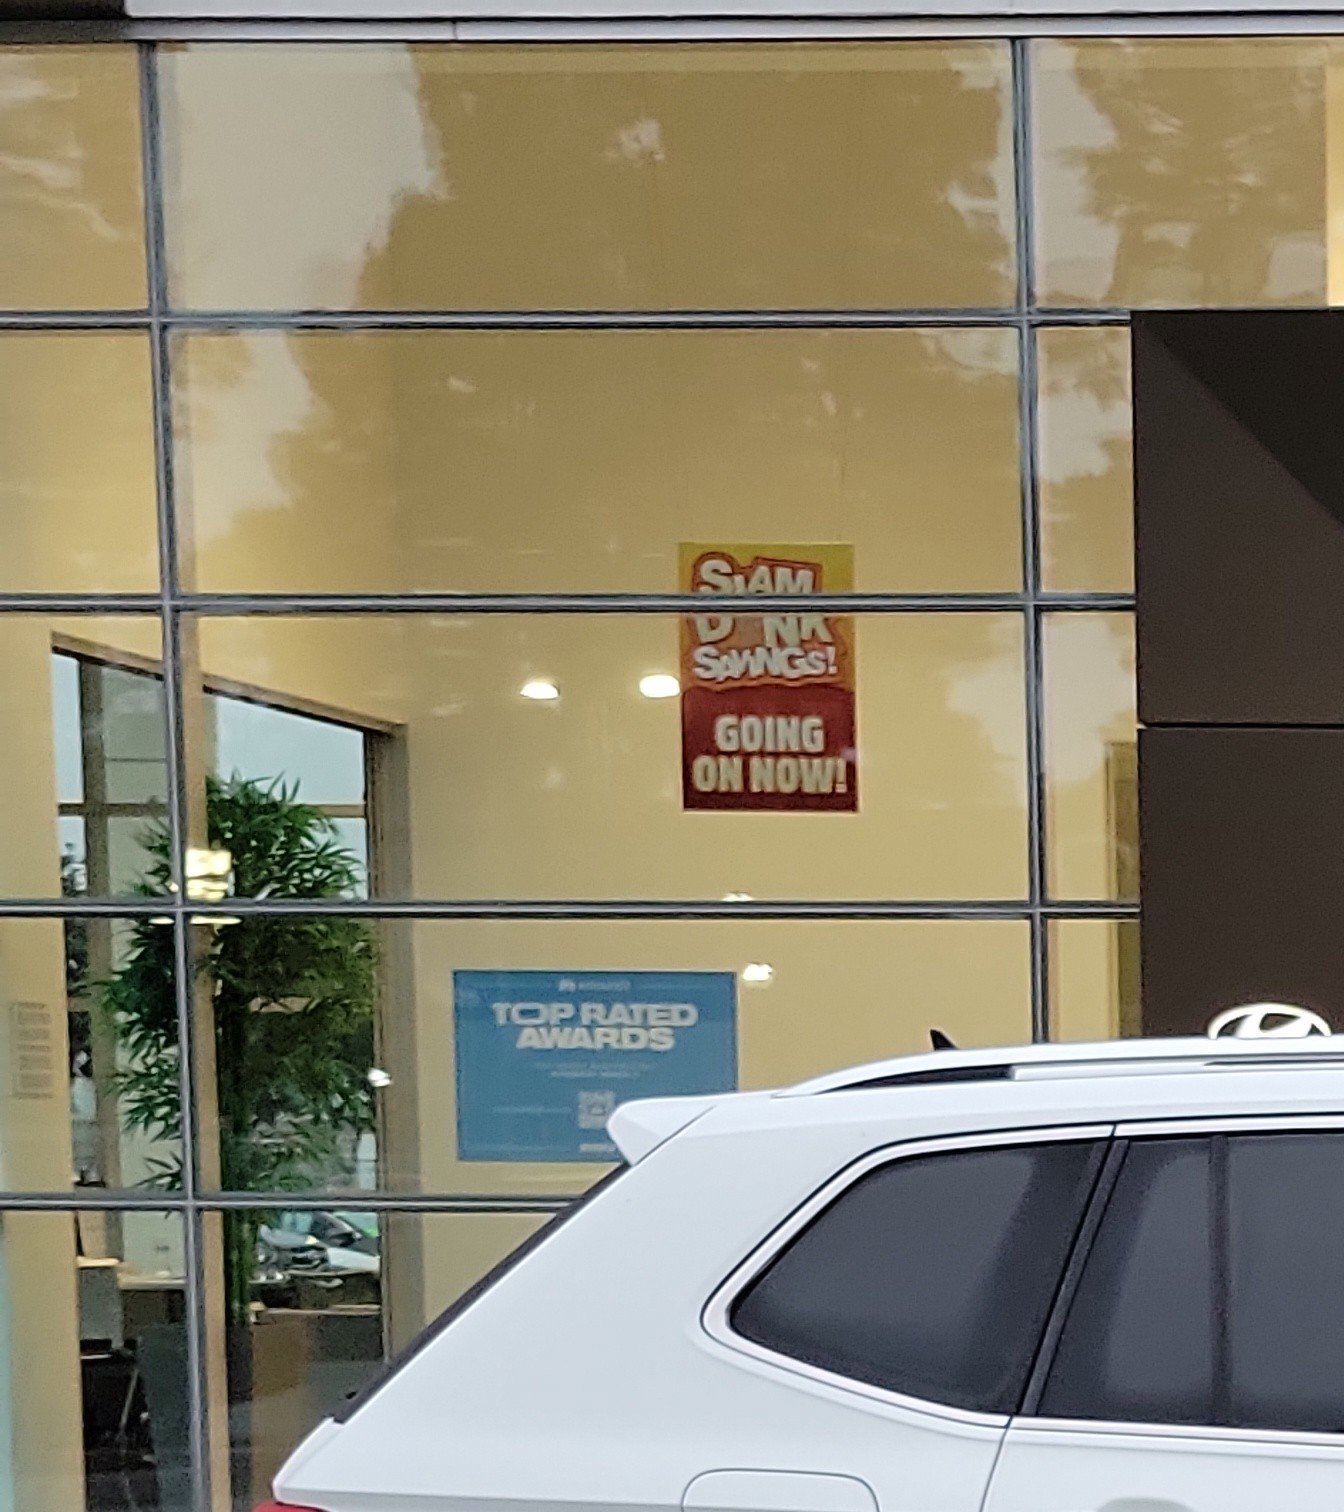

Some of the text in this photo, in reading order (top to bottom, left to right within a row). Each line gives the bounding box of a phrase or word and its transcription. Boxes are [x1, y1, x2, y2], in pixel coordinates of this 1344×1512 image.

[694, 614, 834, 648] DNK
[715, 716, 824, 752] GOING
[693, 756, 848, 793] ON NOW!
[492, 1002, 699, 1027] TOP RATED
[515, 1027, 676, 1050] AWARDS
